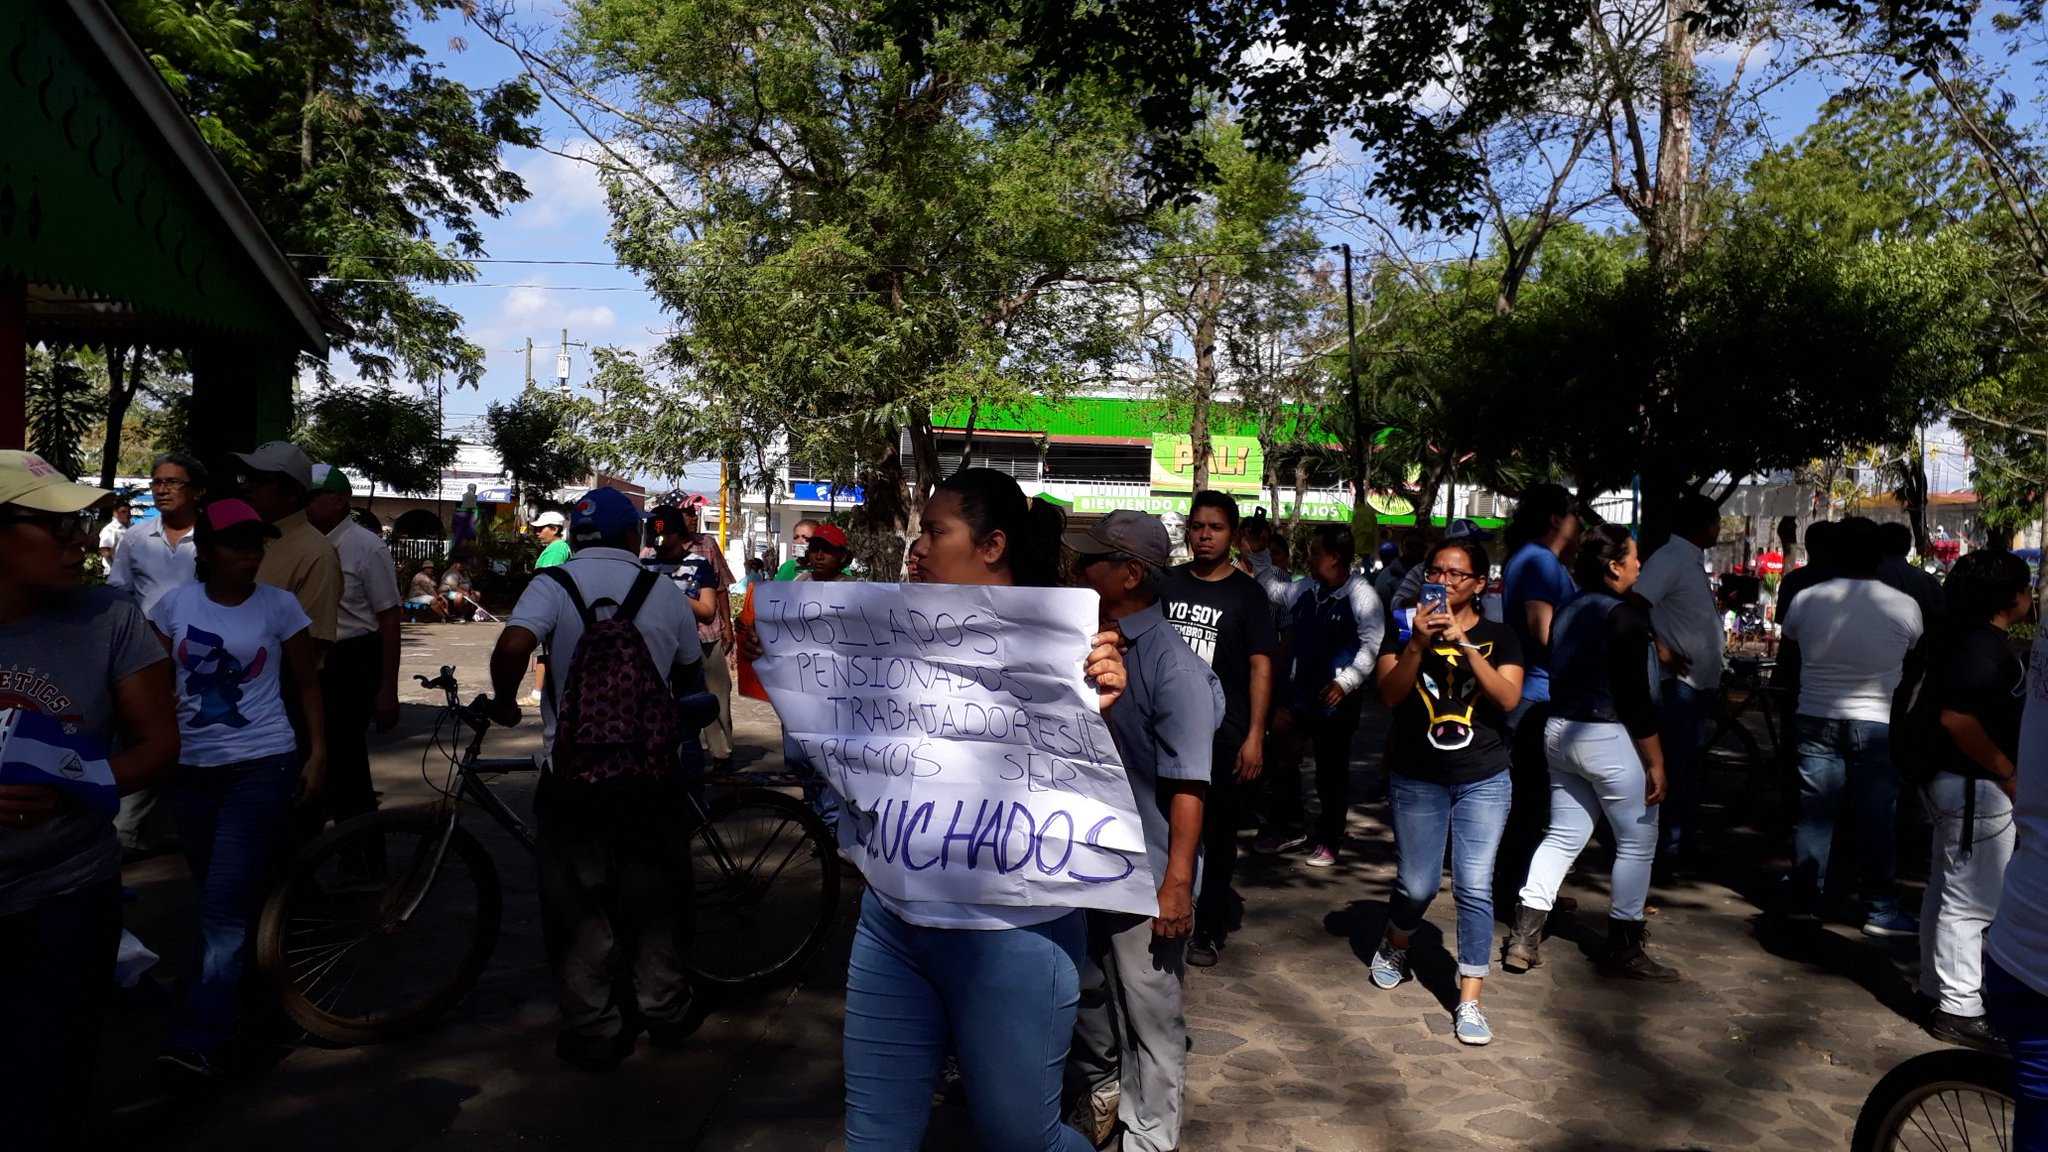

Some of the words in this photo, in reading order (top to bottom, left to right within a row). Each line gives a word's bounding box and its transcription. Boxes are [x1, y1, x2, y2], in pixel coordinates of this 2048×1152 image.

[1081, 498, 1174, 511] BIENVENIDO
[1178, 499, 1188, 512] A
[1292, 504, 1338, 517] AJOS
[770, 599, 998, 655] JUBILADOS
[1171, 624, 1204, 639] EMBRO
[1204, 629, 1218, 641] DE
[797, 652, 1033, 701] PENSIONADOS
[798, 737, 942, 781] EREMOS
[1000, 752, 1087, 798] SER
